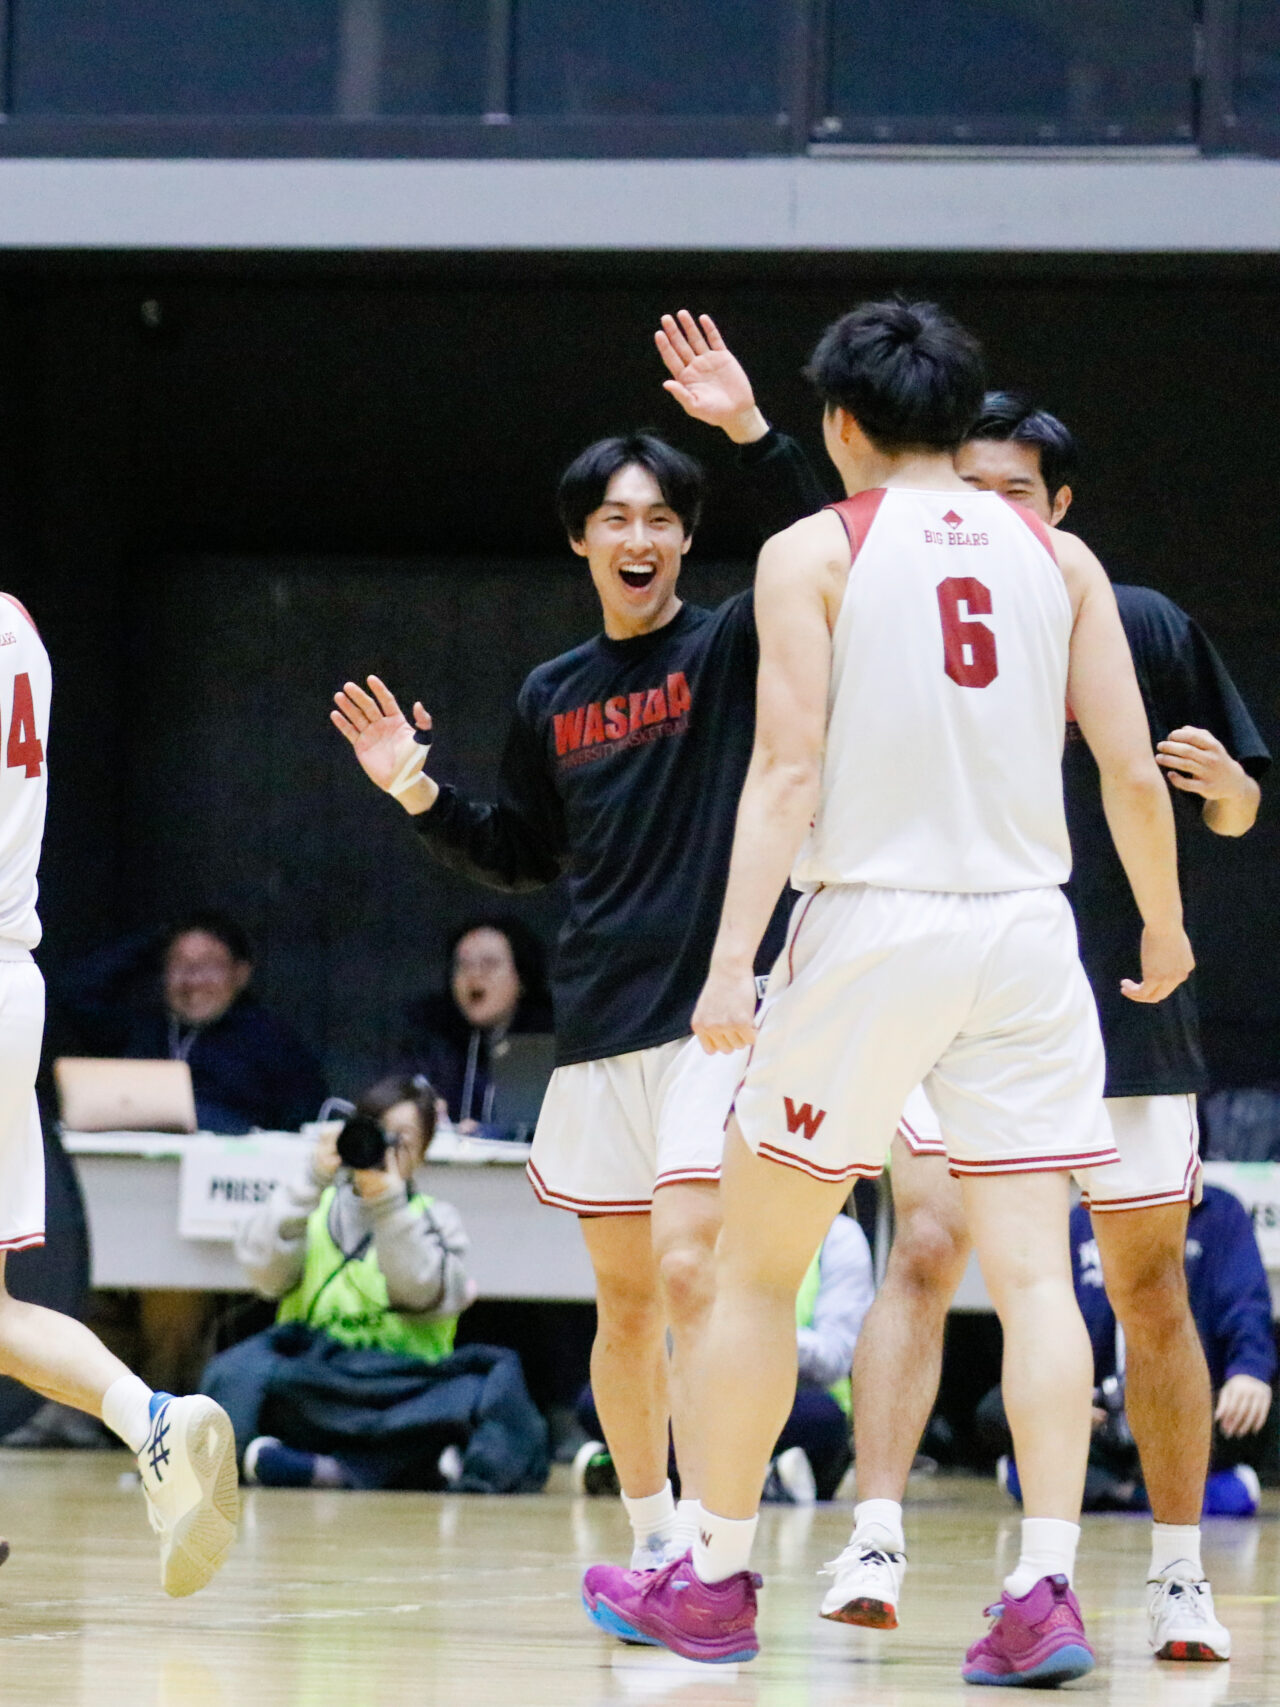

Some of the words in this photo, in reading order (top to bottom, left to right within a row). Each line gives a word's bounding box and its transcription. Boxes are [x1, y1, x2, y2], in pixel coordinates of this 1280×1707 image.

[923, 529, 943, 545] BIG
[948, 532, 989, 546] BEARS
[936, 576, 999, 689] 6
[783, 1095, 827, 1141] W
